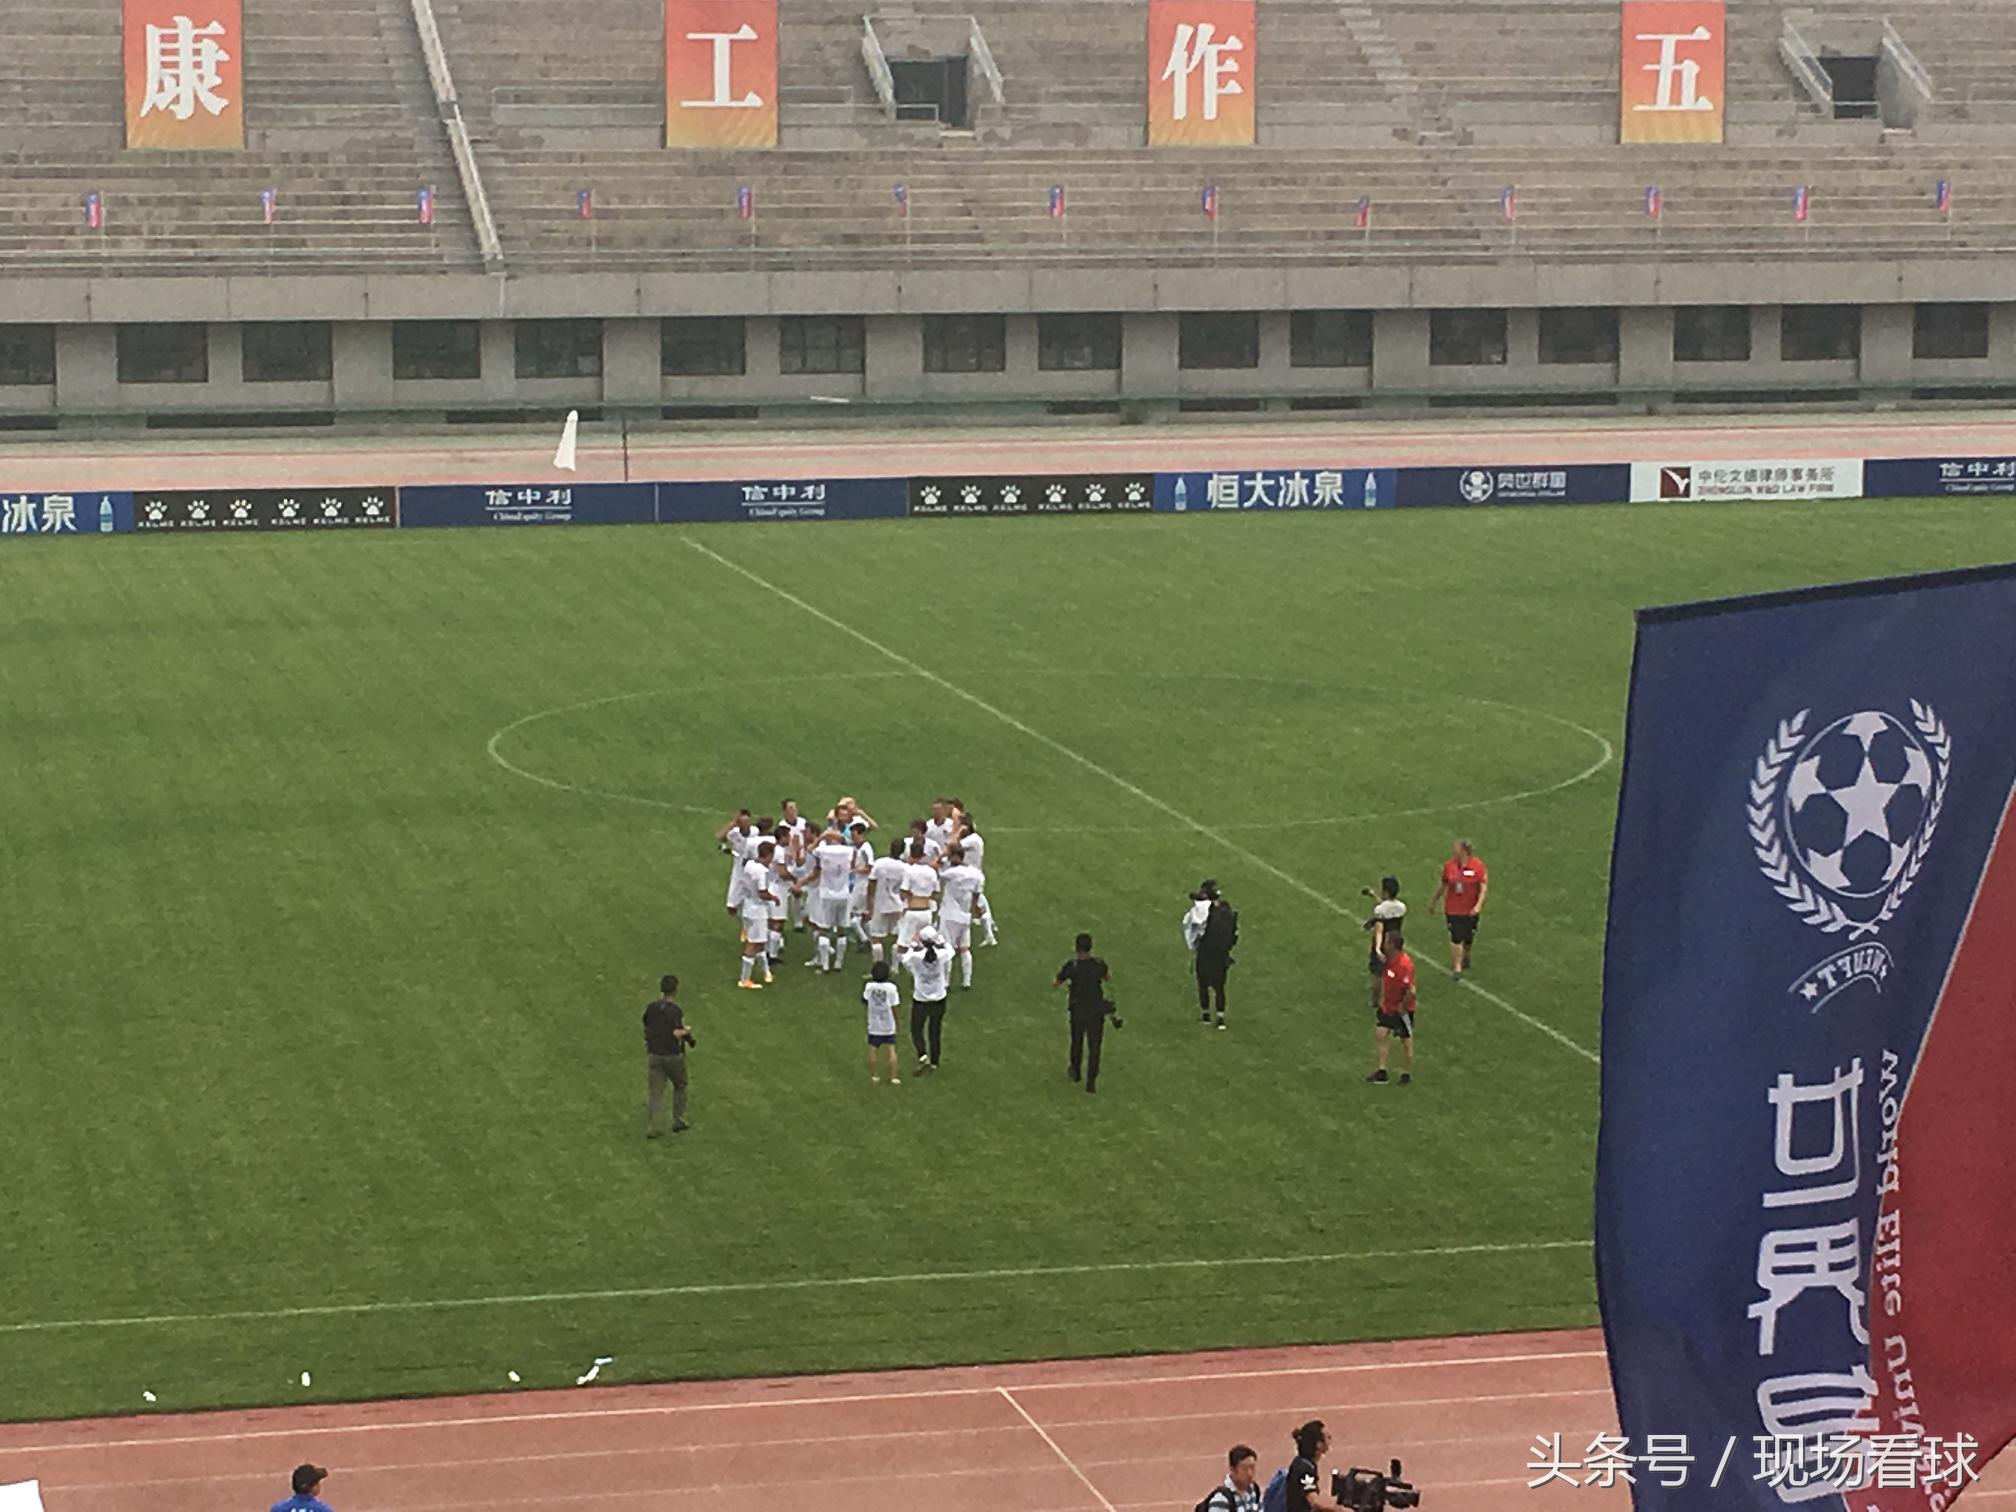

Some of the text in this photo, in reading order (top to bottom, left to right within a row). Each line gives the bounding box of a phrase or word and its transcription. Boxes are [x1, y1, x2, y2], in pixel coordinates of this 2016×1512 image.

[142, 16, 230, 120] 康
[681, 24, 764, 109] 工
[1161, 22, 1245, 121] 作
[1633, 25, 1714, 112] 五
[1, 495, 76, 533] 冰泉
[1207, 472, 1345, 509] 恒大冰泉
